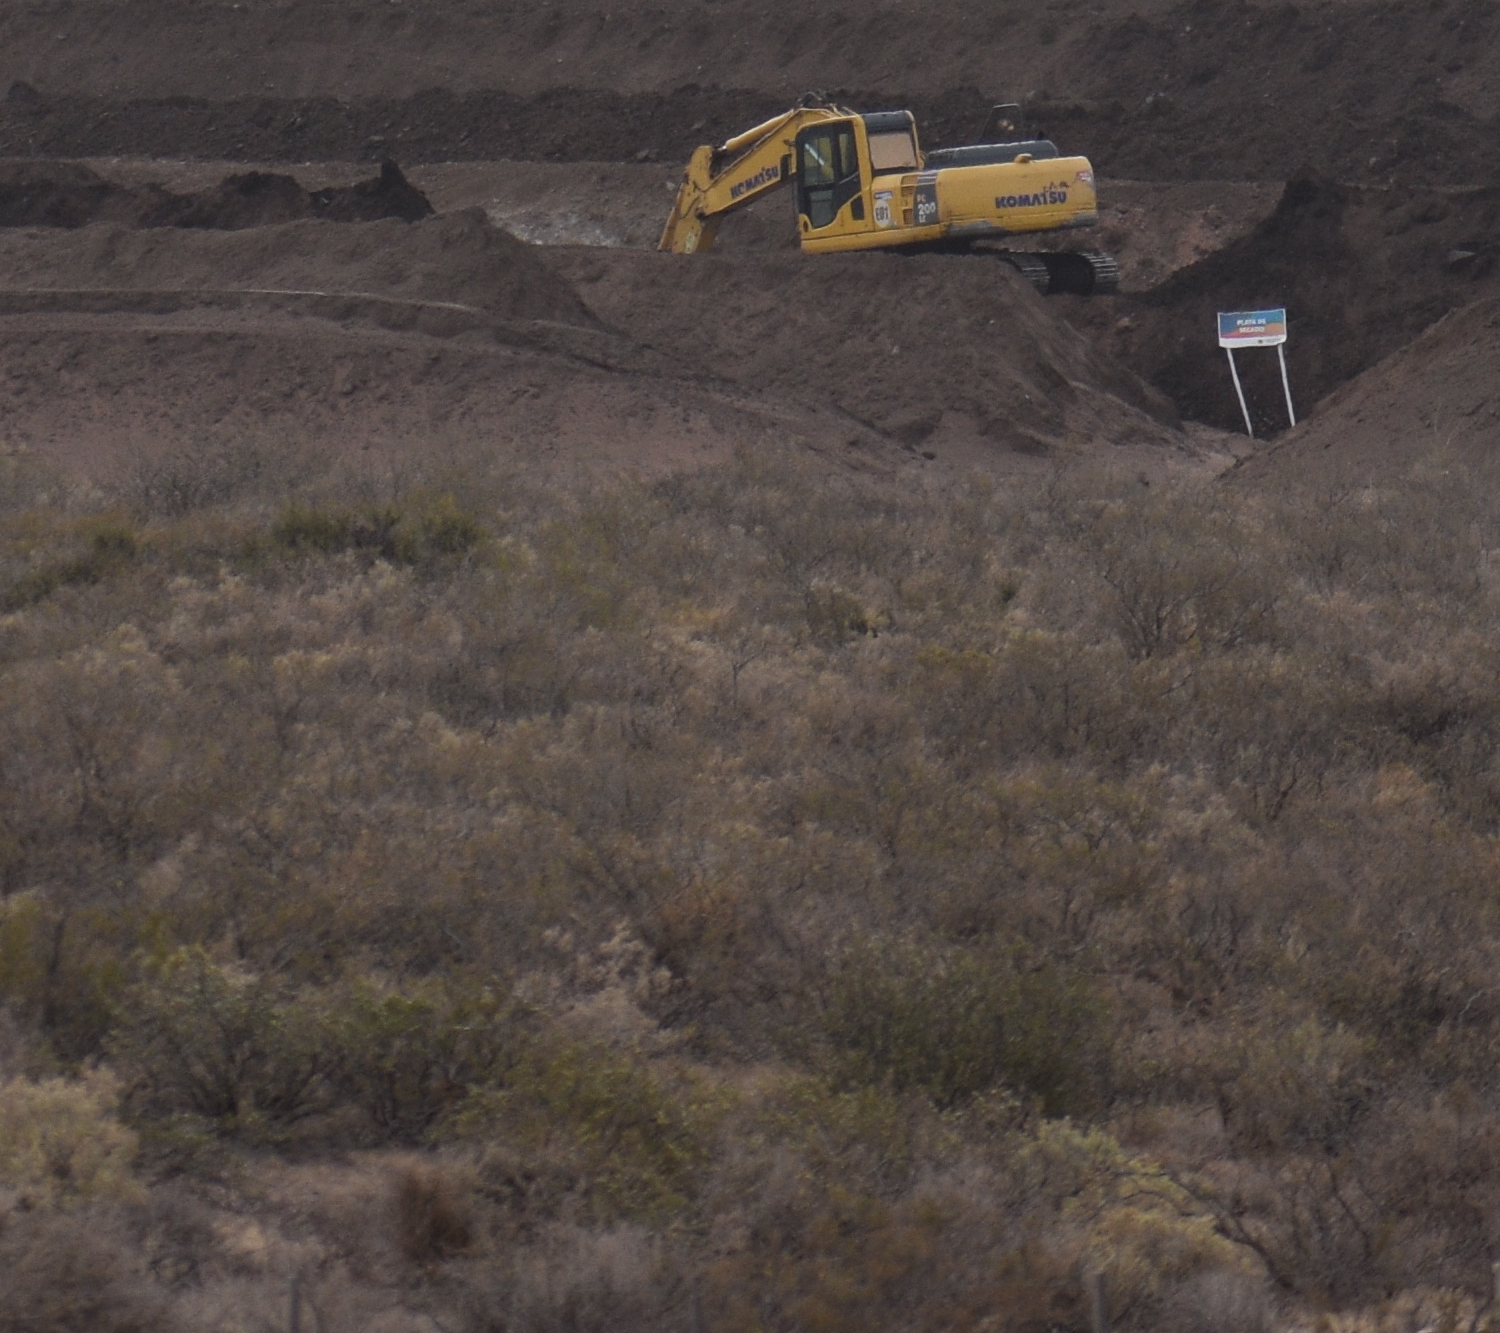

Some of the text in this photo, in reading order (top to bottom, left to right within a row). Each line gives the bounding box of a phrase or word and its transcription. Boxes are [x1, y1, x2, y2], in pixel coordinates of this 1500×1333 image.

[731, 166, 779, 199] KOMATSU
[995, 191, 1067, 208] KOMATSU
[918, 202, 936, 215] 200
